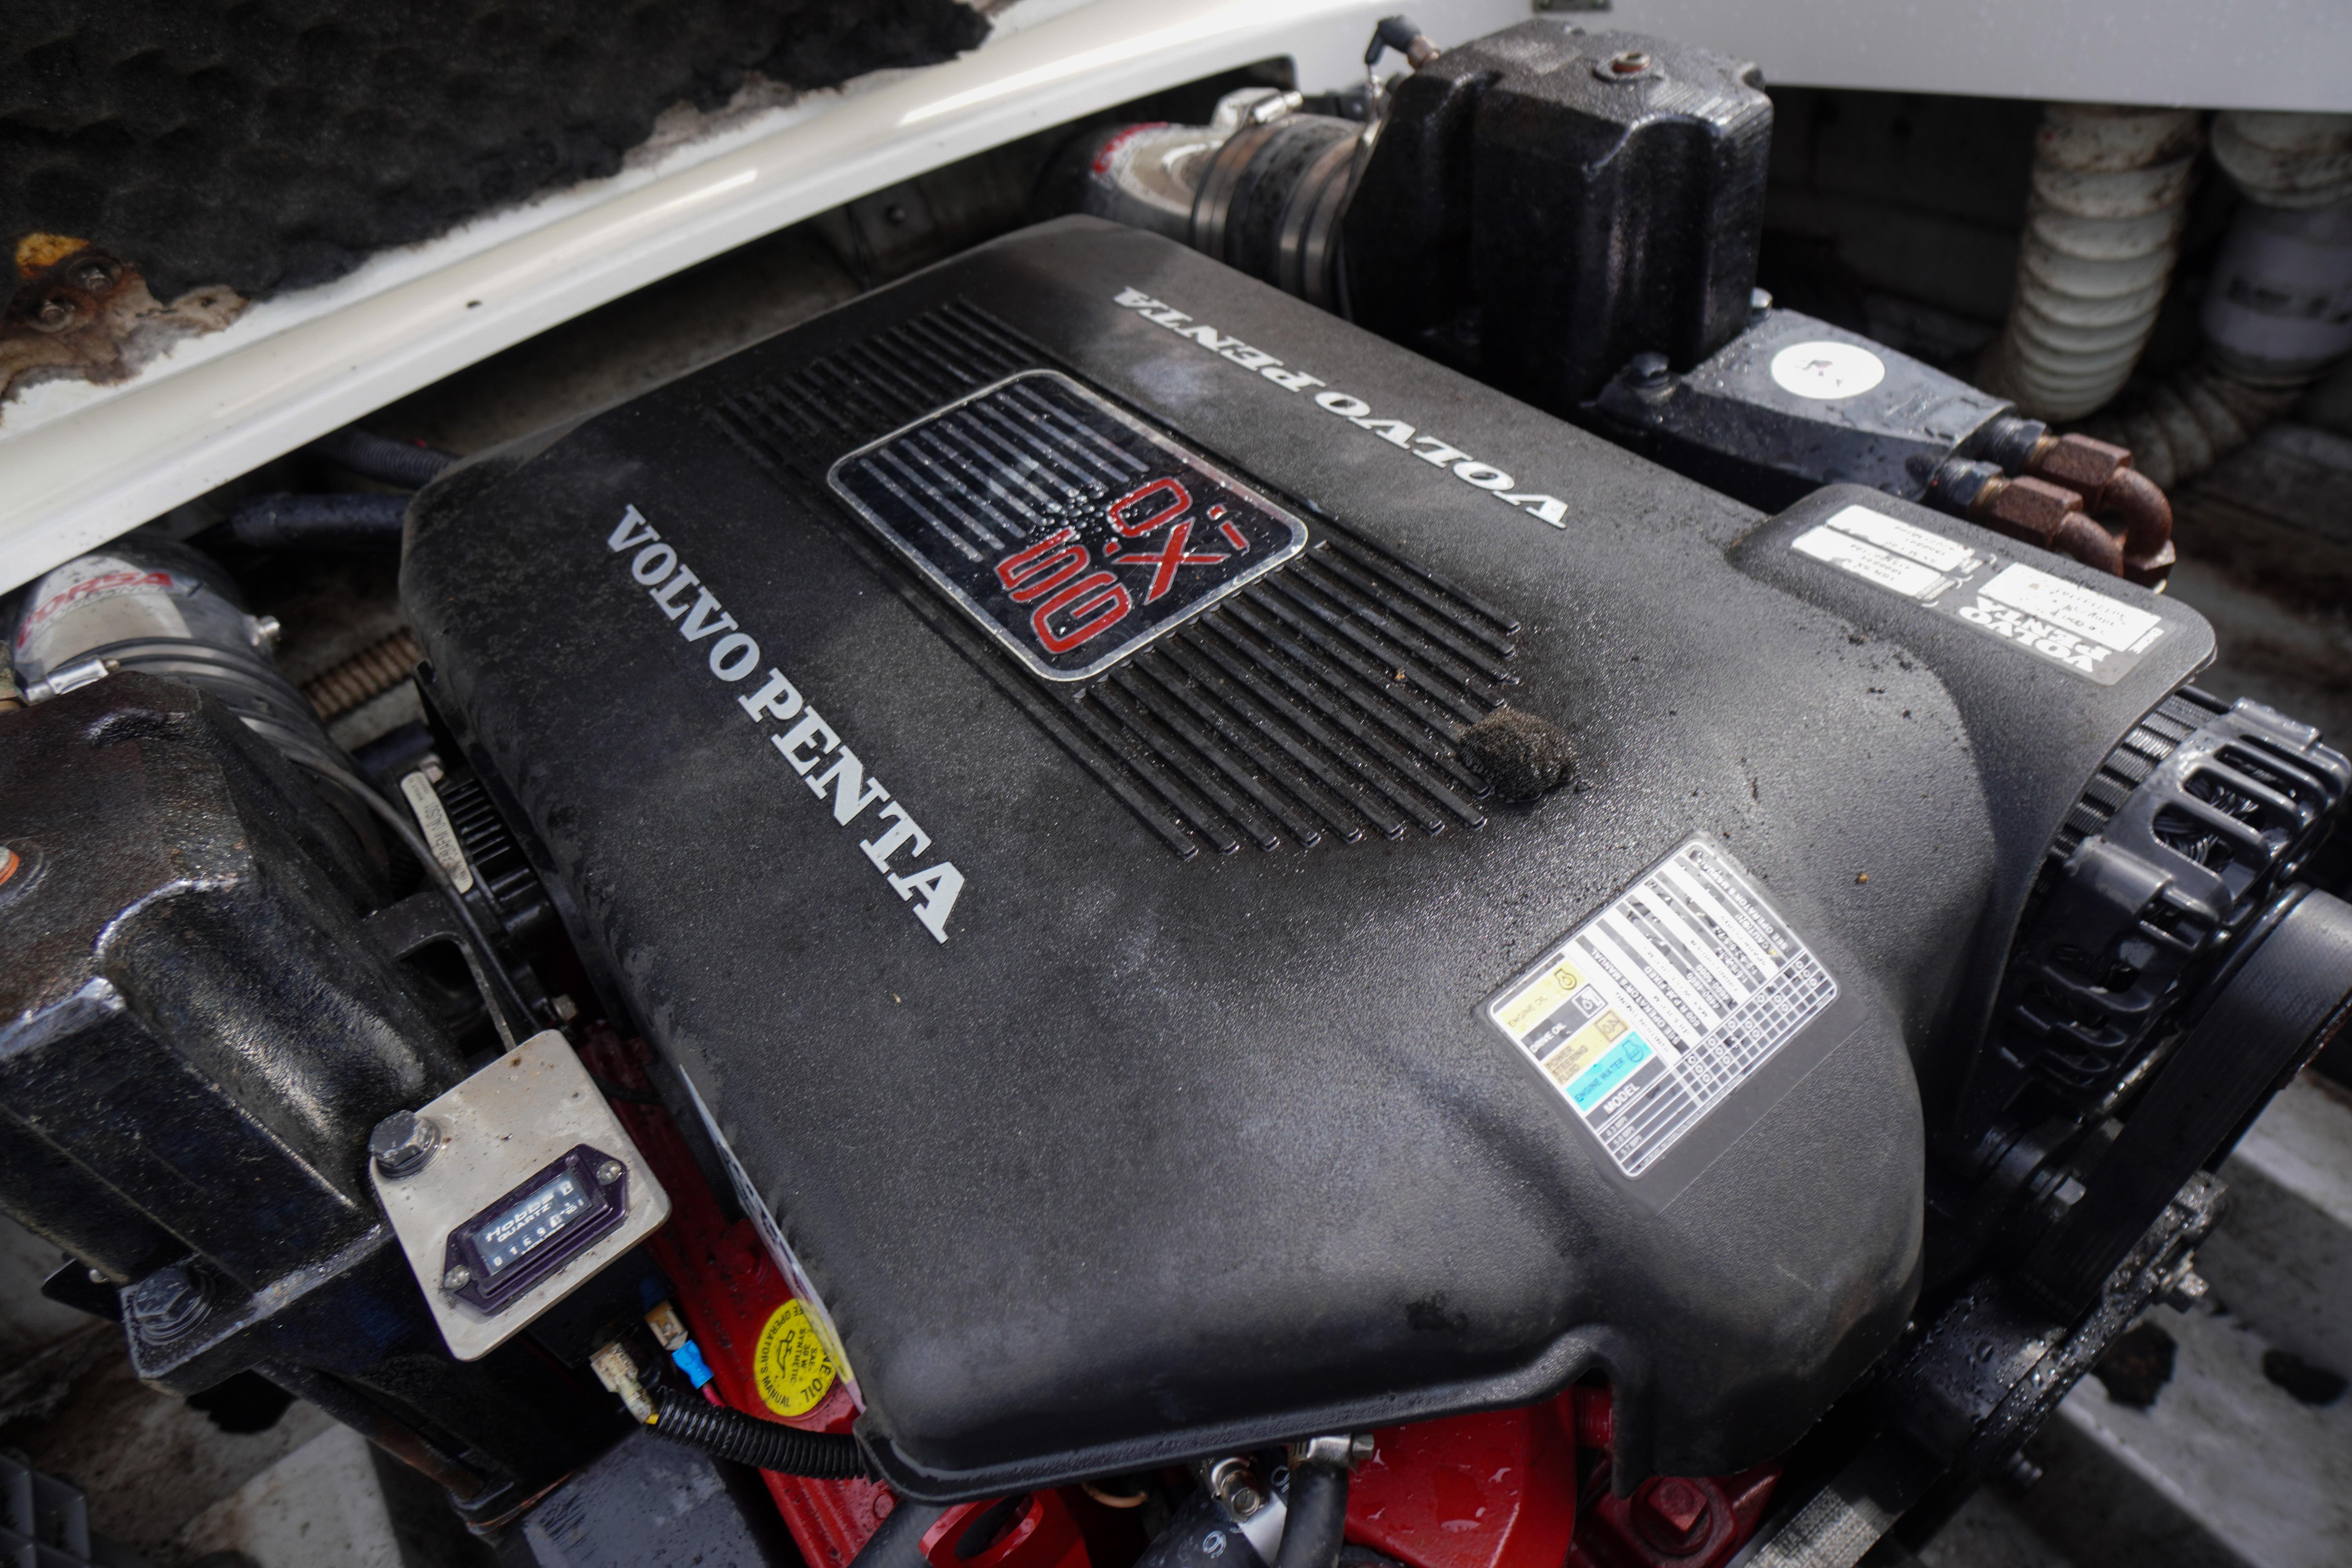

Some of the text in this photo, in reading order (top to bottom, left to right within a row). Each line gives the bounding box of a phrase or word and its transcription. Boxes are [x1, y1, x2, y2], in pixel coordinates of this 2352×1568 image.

[1112, 286, 1569, 529] VOLVO PENTA
[1959, 607, 2094, 673] VOLVO
[1977, 596, 2112, 662] PENTA
[608, 504, 760, 681] VOLVO
[738, 668, 965, 944] PENTA
[1726, 886, 1775, 936] OPERATOR'S
[1733, 911, 1771, 950] CAUTION!
[1770, 932, 1789, 951] SEE
[1508, 994, 1548, 1029] ENGINE OIL
[1589, 946, 1681, 1045] SEE OPERATOR'S MANUAL
[1528, 1020, 1567, 1054] DRIVE OIL
[1684, 1010, 1702, 1028] 600
[1545, 1044, 1575, 1071] POWER
[1551, 1044, 1590, 1078] STEERING
[1557, 1062, 1581, 1084] FLUID
[1573, 1056, 1626, 1103] ENGINE WATER
[1602, 1080, 1641, 1115] MODEL
[485, 1193, 555, 1242] Hobbs
[497, 1200, 552, 1242] QUARTZ
[761, 1311, 791, 1374] OPERATOR'S
[789, 1328, 806, 1384] SYNTHETIC
[762, 1376, 790, 1407] MANUAL
[800, 1378, 822, 1403] OIL
